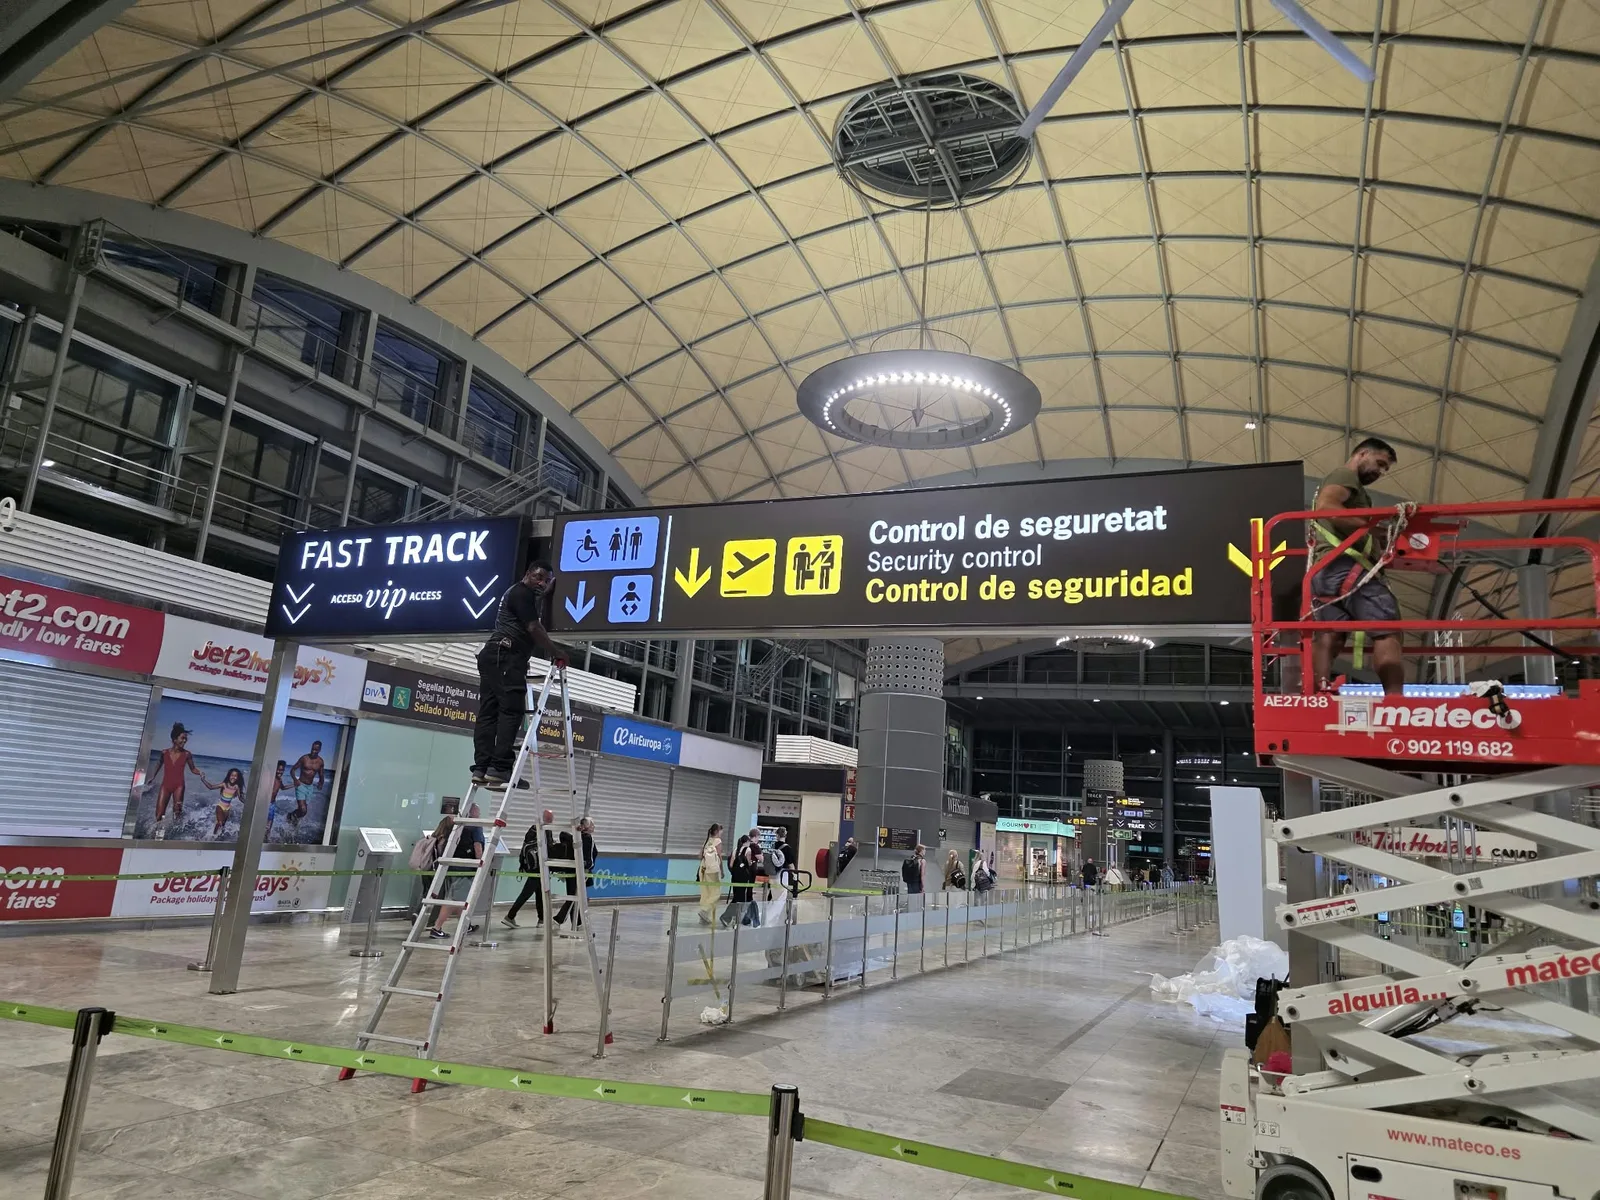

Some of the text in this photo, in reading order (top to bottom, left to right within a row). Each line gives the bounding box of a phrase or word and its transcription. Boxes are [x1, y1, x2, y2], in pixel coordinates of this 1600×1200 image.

[869, 505, 1167, 544] Control de seguretat
[301, 530, 490, 570] FAST TRACK
[867, 544, 1042, 574] Security control
[865, 567, 1193, 604] Control de seguridad
[330, 580, 442, 620] ACCESO vip ACCESS
[36, 626, 71, 646] low
[74, 633, 121, 656] fares
[188, 661, 221, 675] Package
[222, 668, 253, 681] holidays
[415, 690, 460, 707] Digital Tax Free
[417, 679, 445, 693] Segellat
[445, 684, 466, 697] Digital
[466, 689, 477, 700] Tax
[413, 702, 477, 722] Sellado Digital Ta
[1263, 695, 1329, 708] AE27138
[1373, 703, 1522, 730] mateco
[539, 725, 561, 738] Sellado
[1407, 739, 1514, 757] 902 119 682
[6, 892, 57, 909] fares
[150, 895, 186, 904] Package
[186, 894, 219, 905] holidays
[1386, 1129, 1522, 1160] www.mateco.es
